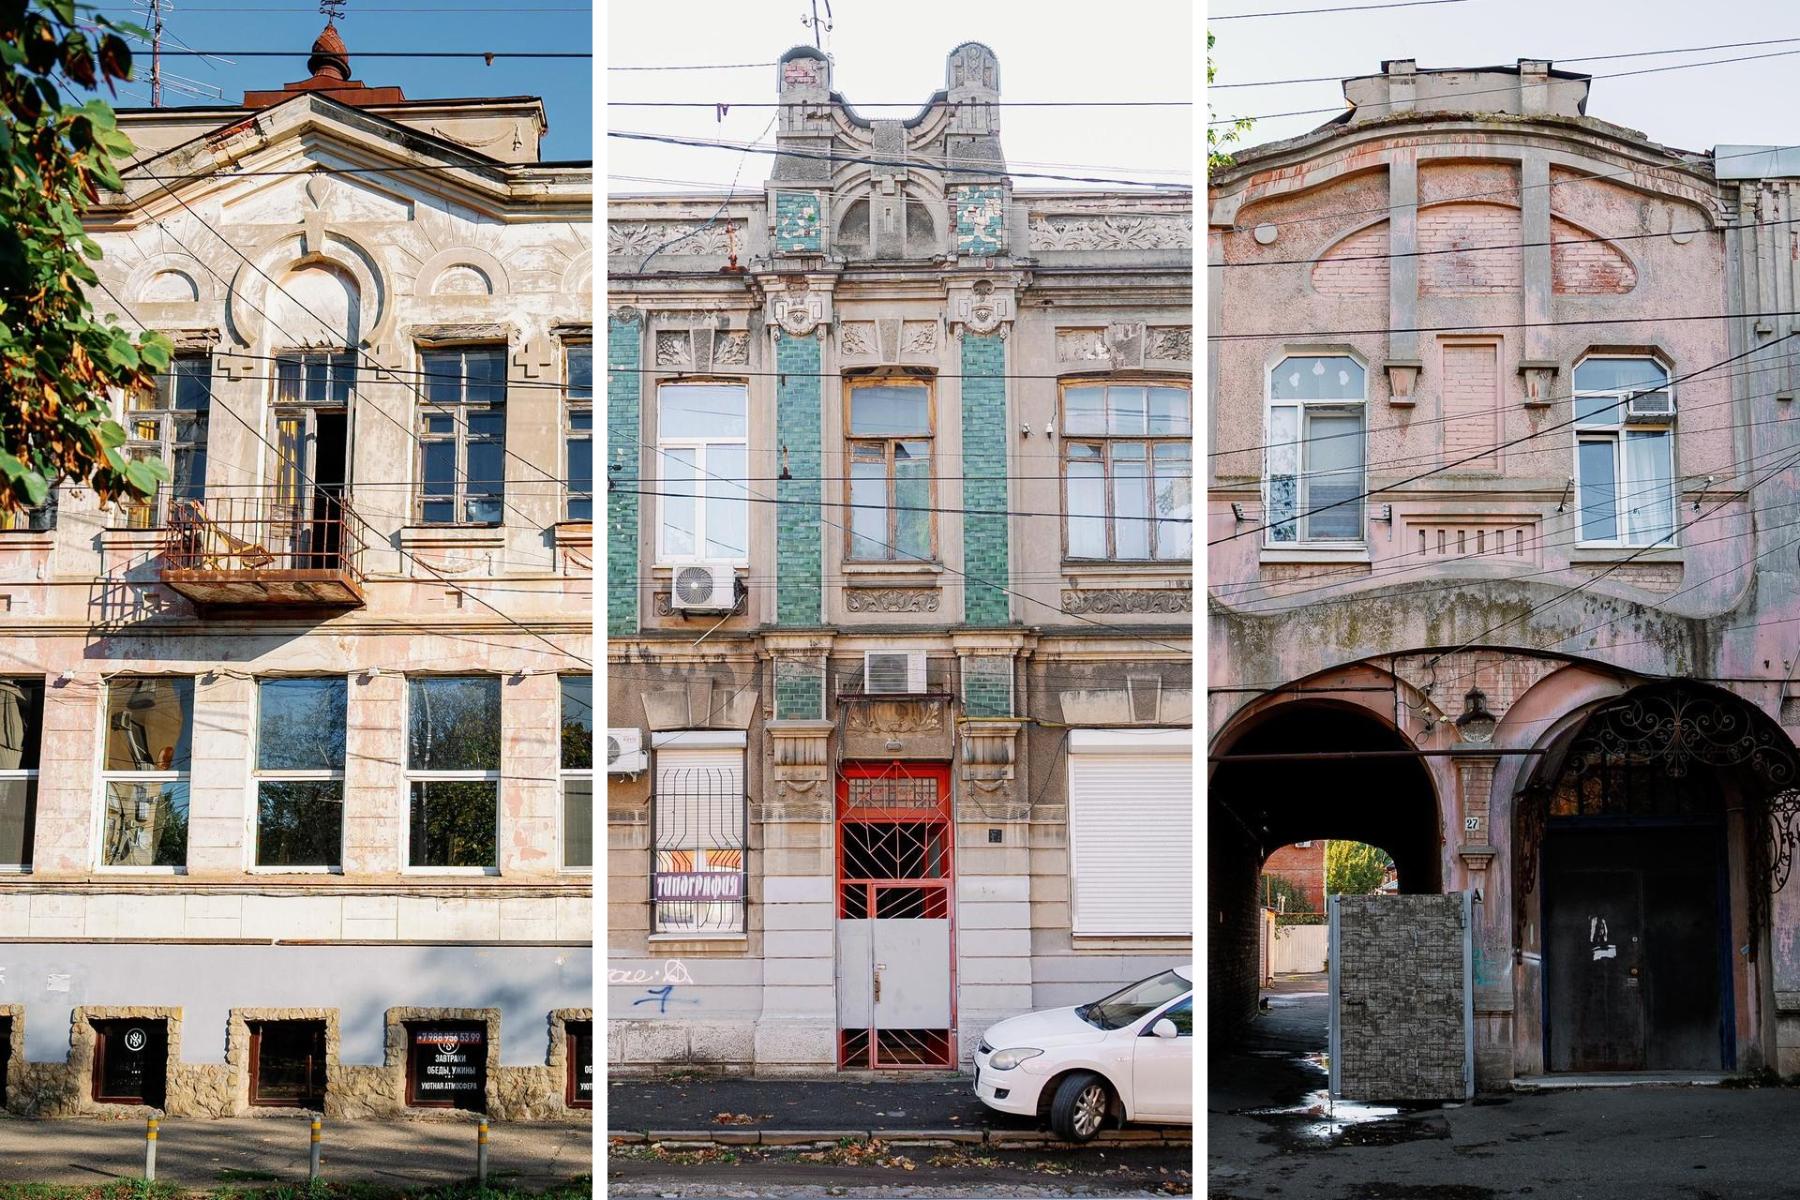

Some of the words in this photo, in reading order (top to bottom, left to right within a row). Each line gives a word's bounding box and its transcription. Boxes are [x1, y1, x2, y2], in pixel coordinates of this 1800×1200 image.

[1466, 818, 1478, 829] 27
[657, 875, 739, 899] ТИПОГРАФИЯ
[435, 1054, 467, 1063] ЗАВТРАКИ
[451, 1066, 476, 1075] УЖИНЫ
[421, 1082, 444, 1090] УЮТНАЯ
[444, 1082, 478, 1090] АТМОСФЕРА
